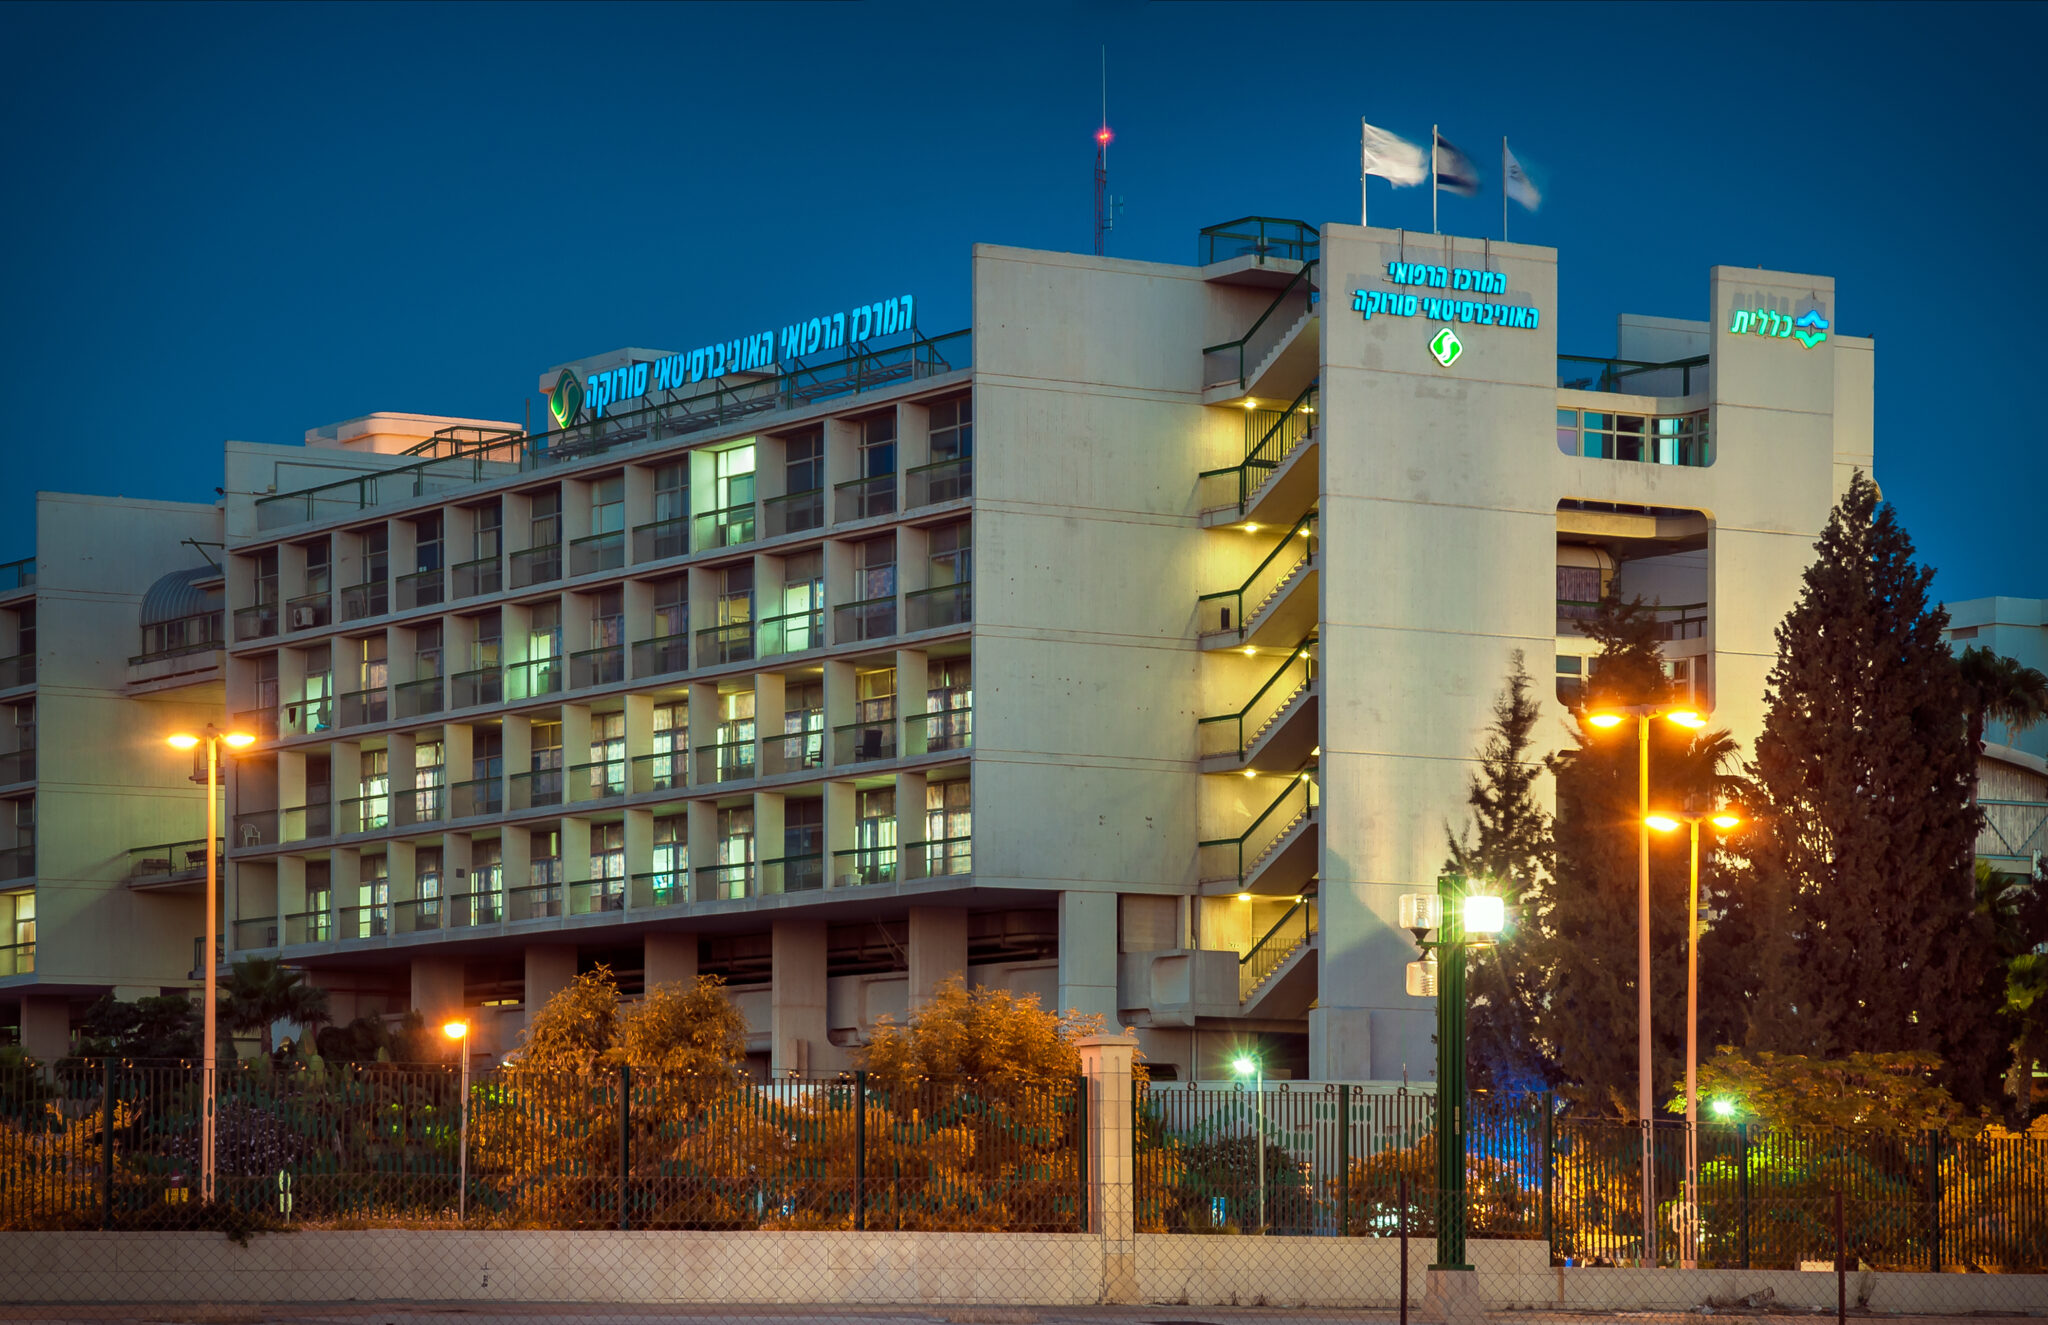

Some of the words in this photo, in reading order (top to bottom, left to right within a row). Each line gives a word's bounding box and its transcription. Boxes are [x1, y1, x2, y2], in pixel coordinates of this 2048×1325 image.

[1387, 261, 1448, 288] הרפואי
[1452, 267, 1507, 295] המרכז
[851, 294, 914, 344] המרכז
[1353, 289, 1418, 320] סורוקה
[1420, 296, 1540, 329] האוניברסיטאי
[781, 311, 846, 360] הרפואי
[1730, 308, 1793, 338] כללית
[653, 330, 775, 391] האוניברסיטאי
[585, 362, 649, 418] סורוקה
